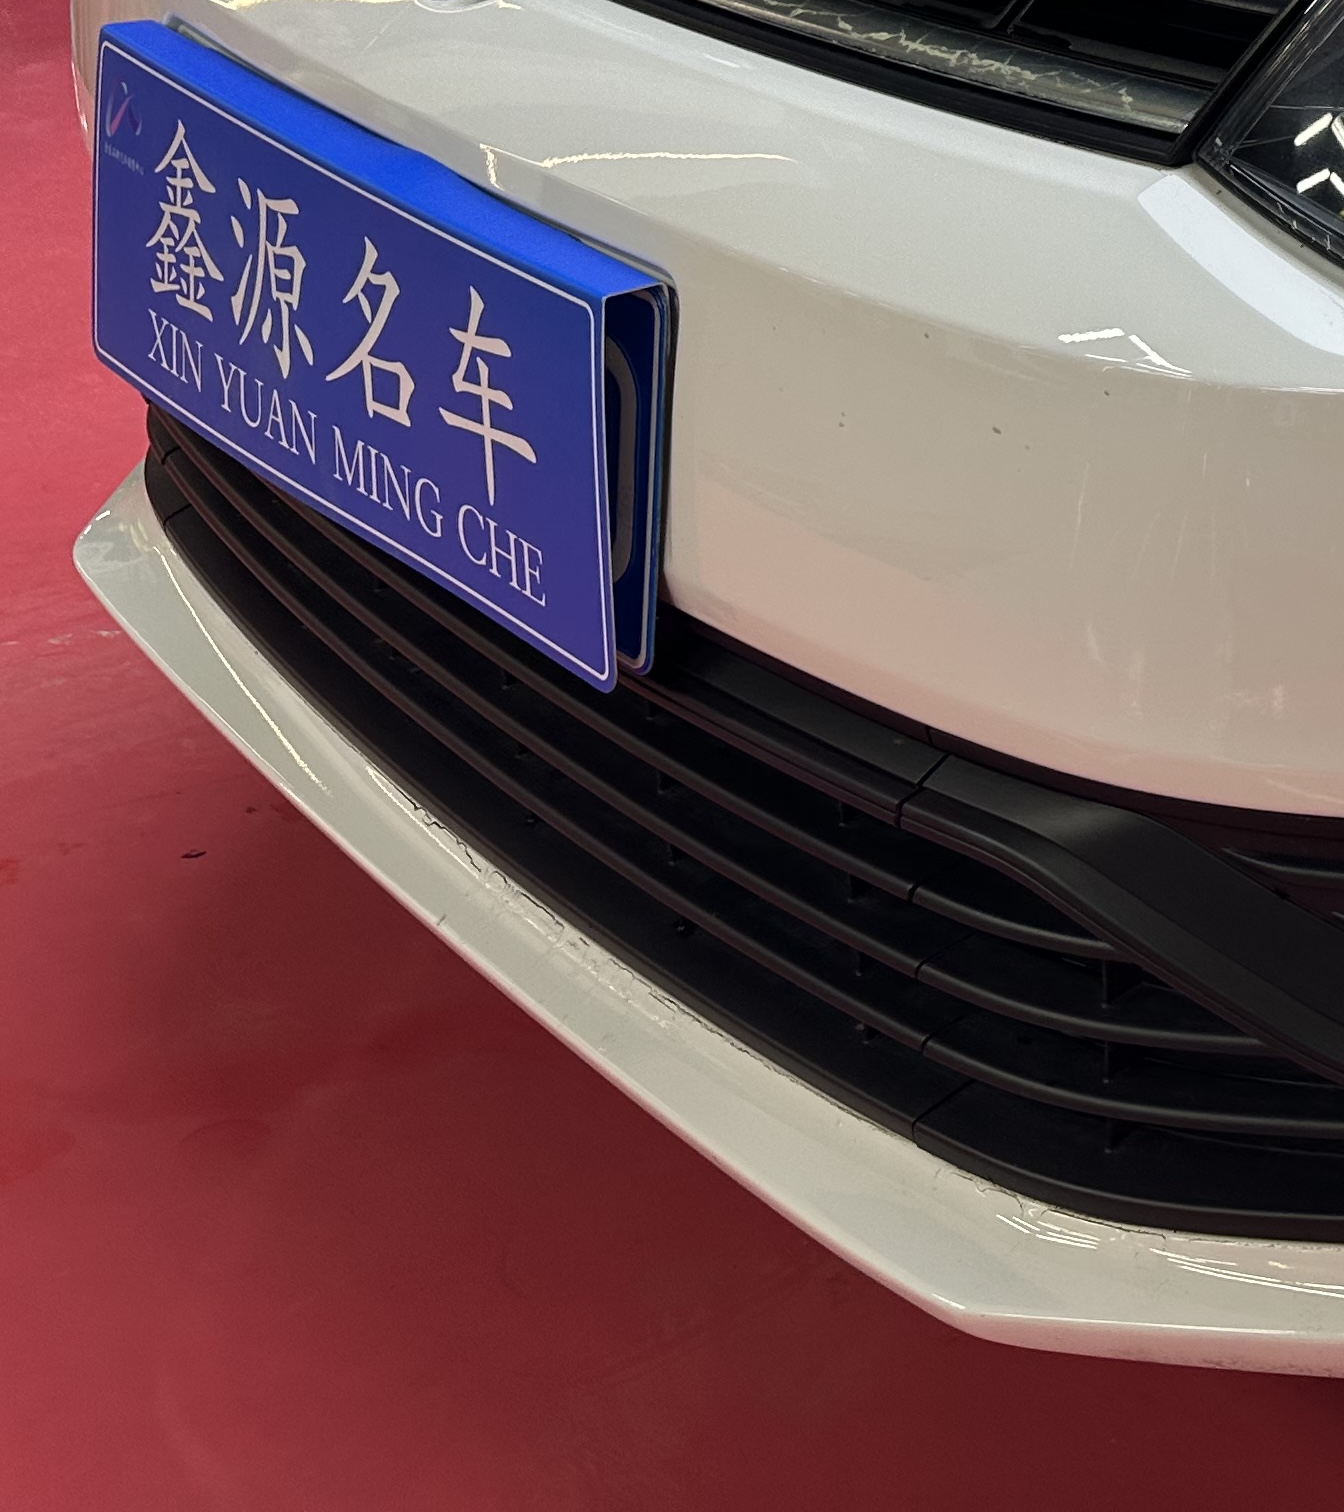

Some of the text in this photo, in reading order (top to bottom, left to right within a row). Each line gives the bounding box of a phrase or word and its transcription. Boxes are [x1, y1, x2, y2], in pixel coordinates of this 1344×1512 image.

[145, 118, 537, 506] 鑫源名车
[147, 309, 547, 608] XIN YUAN MING CHE
